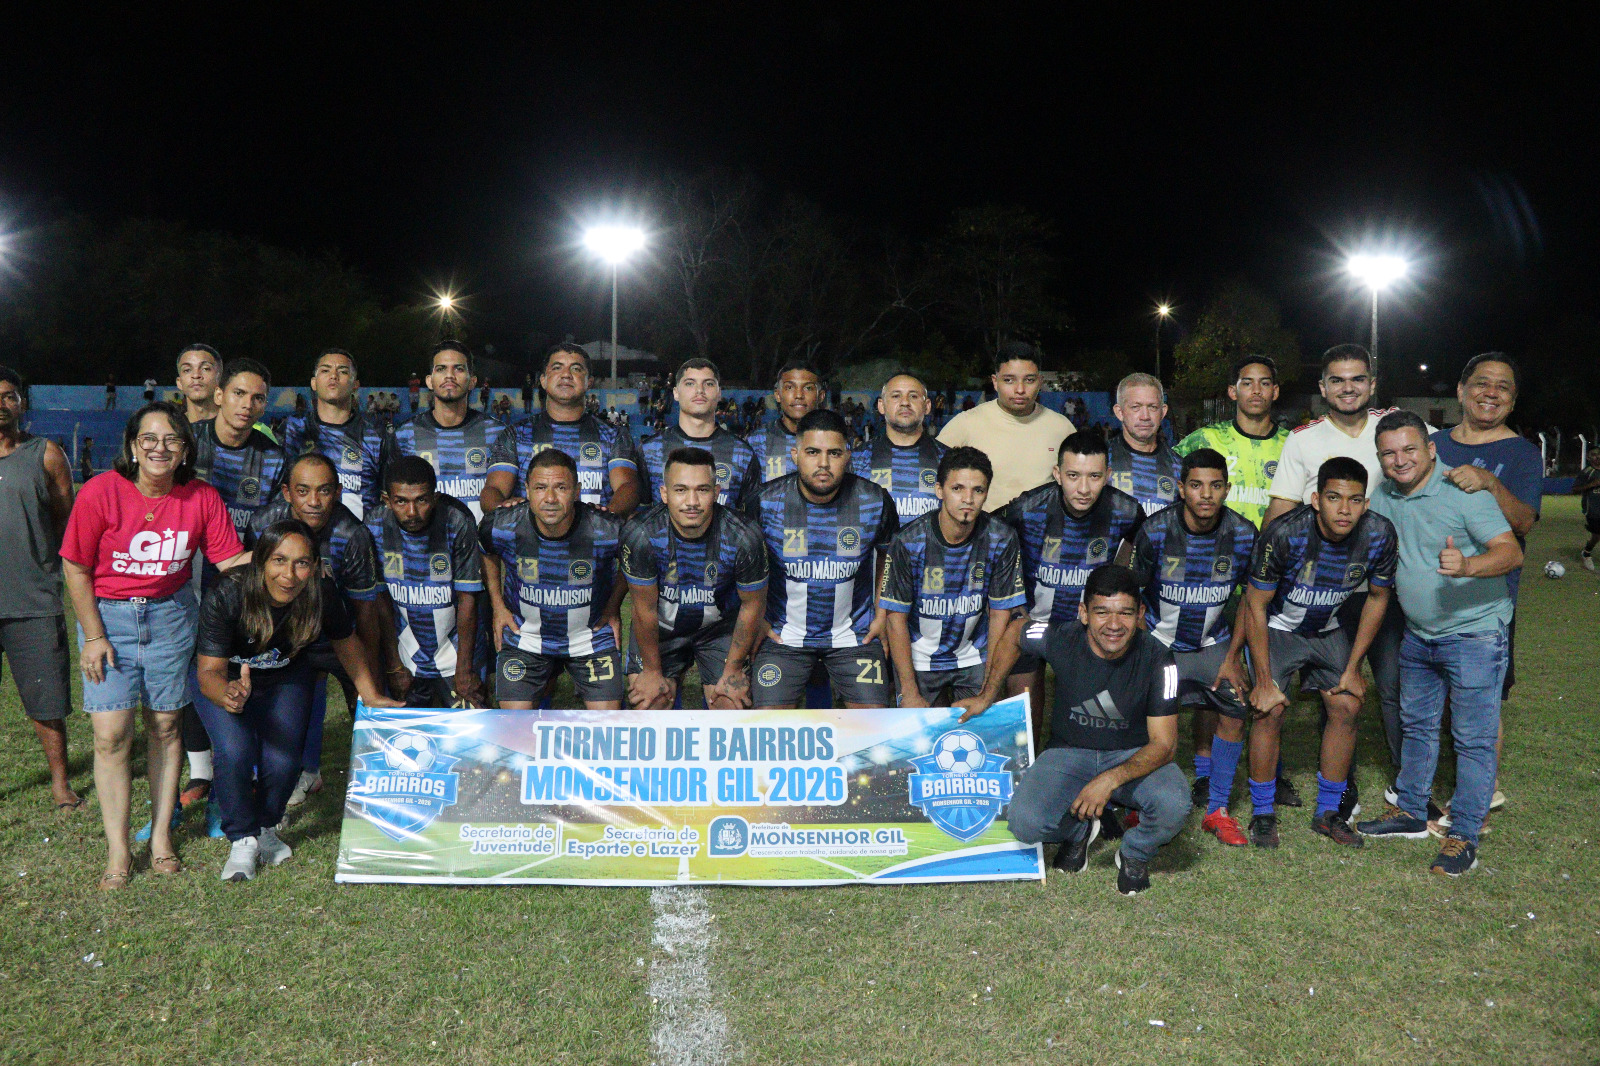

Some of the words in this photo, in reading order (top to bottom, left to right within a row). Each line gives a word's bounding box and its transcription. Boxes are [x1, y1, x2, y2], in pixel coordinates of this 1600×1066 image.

[767, 457, 783, 477] 11
[1112, 472, 1133, 491] 15
[783, 529, 807, 553] 21
[112, 550, 132, 561] DR.
[516, 557, 538, 580] 13
[1167, 556, 1180, 578] 7
[923, 567, 944, 590] 18
[519, 583, 542, 604] JOÃO
[543, 586, 592, 606] MÁDISON
[1160, 583, 1186, 602] JOÃO
[1186, 583, 1231, 604] MÁDISON
[919, 595, 947, 616] JOÃO
[585, 656, 615, 683] 13
[856, 658, 884, 685] 21
[1069, 712, 1130, 731] ADIDAS
[538, 725, 657, 761] TORNEIO
[665, 727, 700, 761] DE
[709, 726, 834, 761] BAIRROS
[364, 776, 446, 796] BAIRROS
[525, 765, 708, 802] MONSENHOR
[717, 767, 760, 802] GIL
[769, 766, 844, 801] 2026
[922, 778, 1001, 798] BAIRROS
[461, 825, 530, 838] Secretaria
[535, 825, 553, 838] de
[606, 827, 675, 840] Secretaria
[680, 827, 697, 840] de
[750, 830, 870, 845] MONSENHOR
[875, 830, 905, 844] GIL
[472, 840, 552, 853] Juventude
[567, 841, 629, 858] Esporte
[633, 845, 645, 855] e
[650, 843, 698, 856] Lazer
[888, 848, 905, 856] gente
